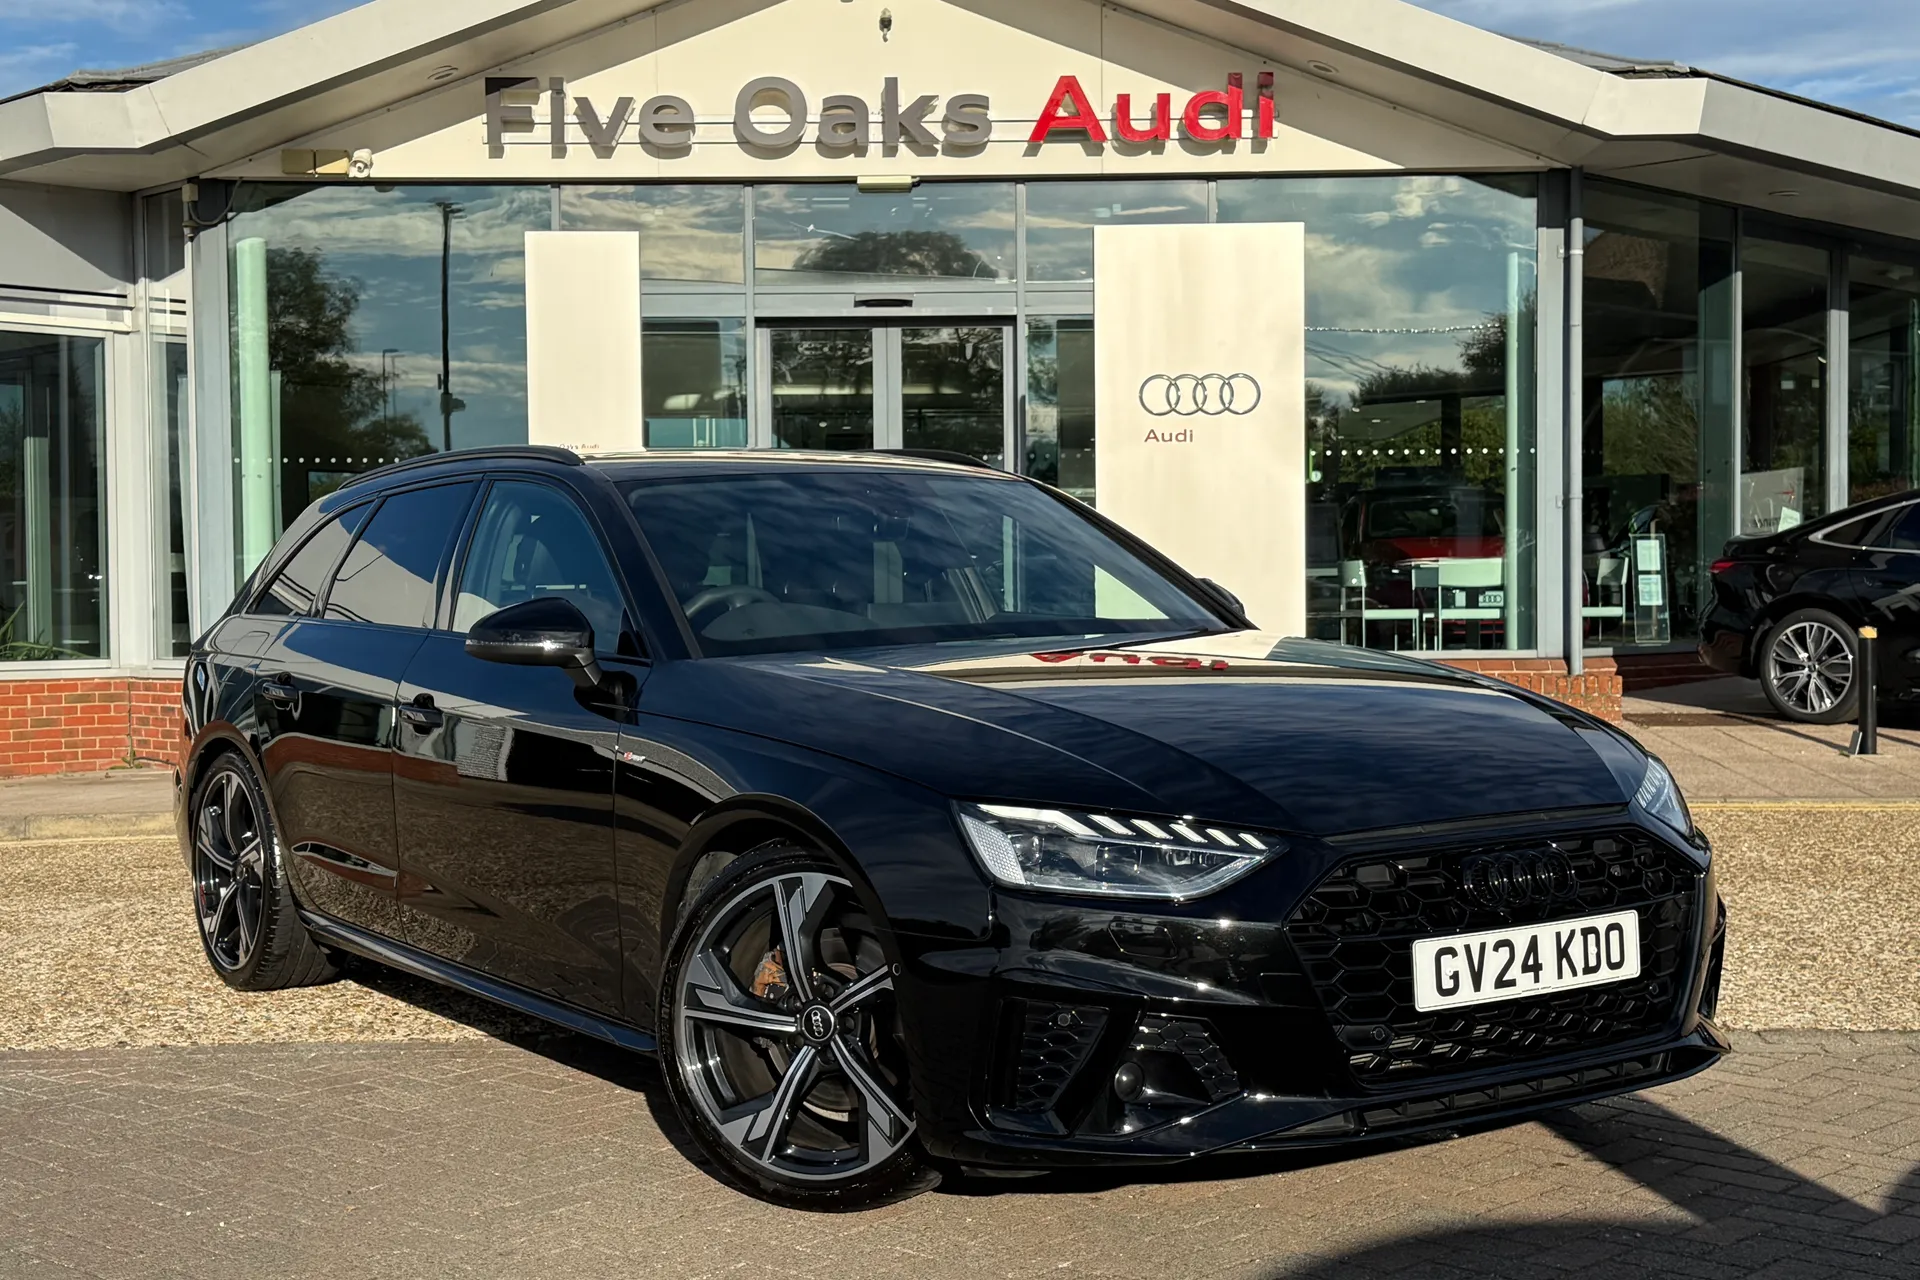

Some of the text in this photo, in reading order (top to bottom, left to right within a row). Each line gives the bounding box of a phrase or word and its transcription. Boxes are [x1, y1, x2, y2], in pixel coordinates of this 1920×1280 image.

[485, 71, 1275, 149] Five Oaks Audi
[1144, 429, 1194, 443] Audi
[1434, 922, 1625, 998] GV24 KDO
